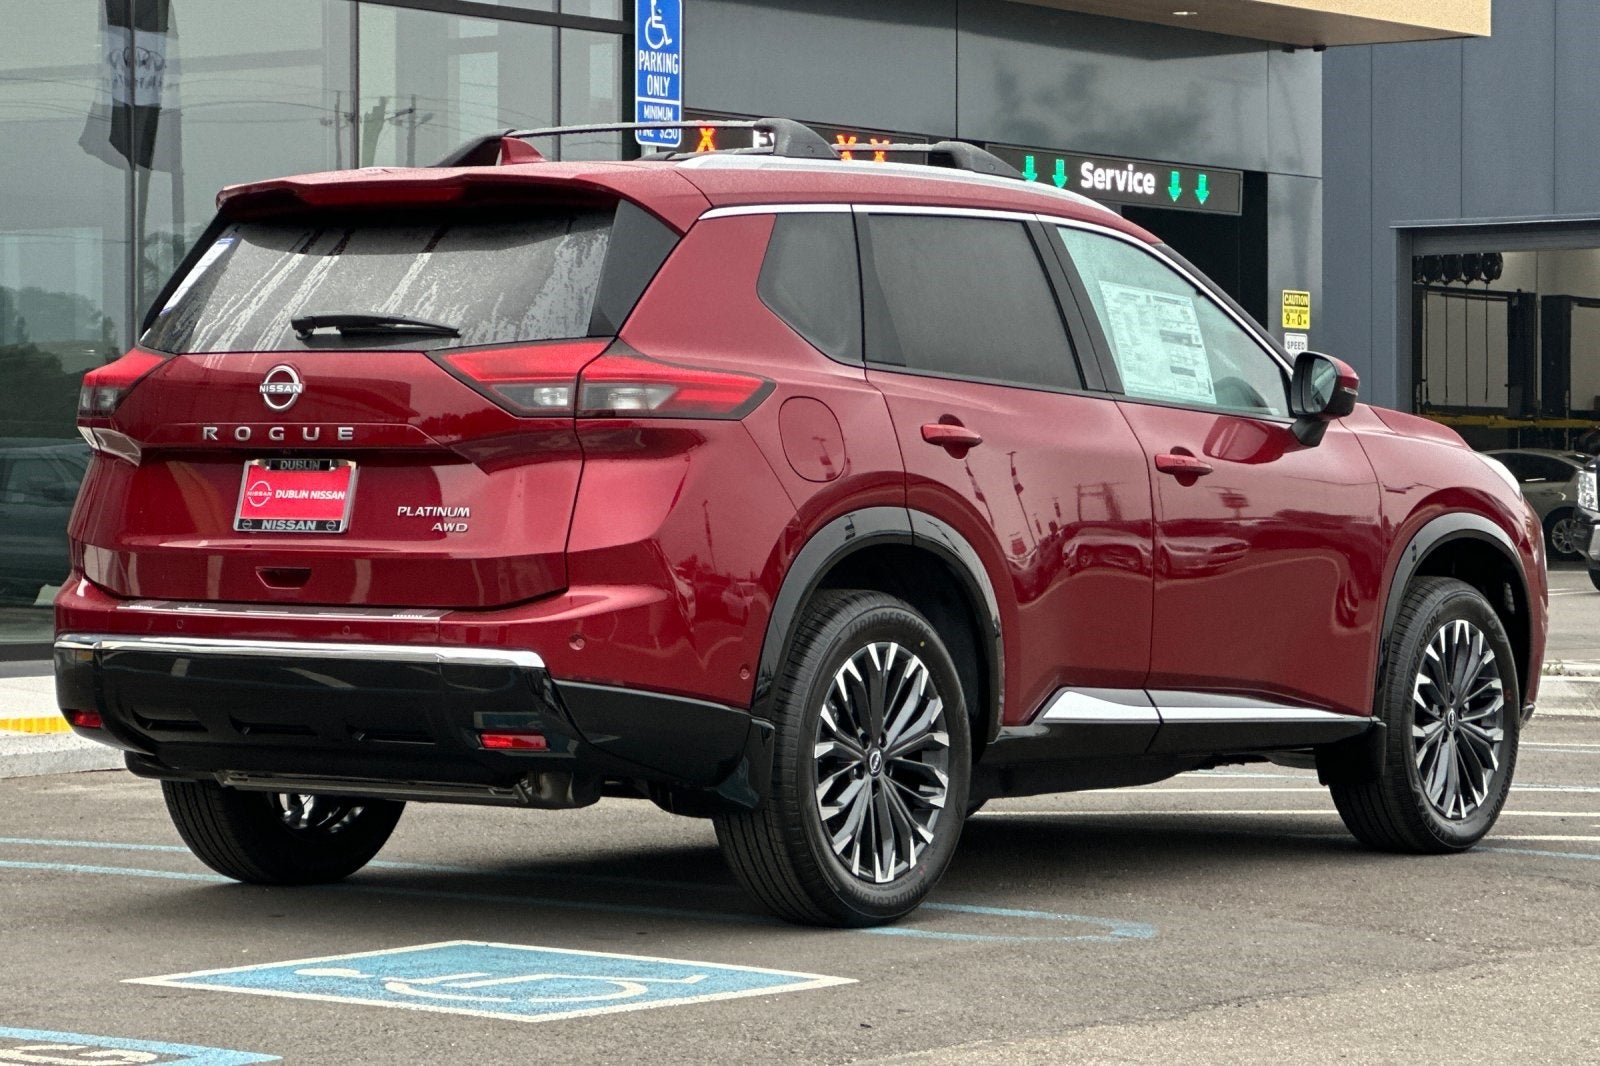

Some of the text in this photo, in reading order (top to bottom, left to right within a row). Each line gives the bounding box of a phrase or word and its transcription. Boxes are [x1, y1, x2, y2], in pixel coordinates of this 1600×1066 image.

[639, 50, 679, 75] PARKING
[647, 74, 670, 97] ONLY
[643, 105, 673, 121] MINIMUM
[1080, 161, 1156, 195] Service
[1284, 293, 1309, 306] CAUTION
[1287, 341, 1305, 350] SPEED
[259, 383, 303, 394] NISSAN
[202, 426, 355, 442] ROGUE
[280, 460, 321, 471] DUBLIN
[275, 489, 346, 500] DUBLIN NISSAN
[397, 506, 471, 518] PLATINUM
[261, 520, 318, 531] NISSAN
[431, 522, 469, 533] AWD
